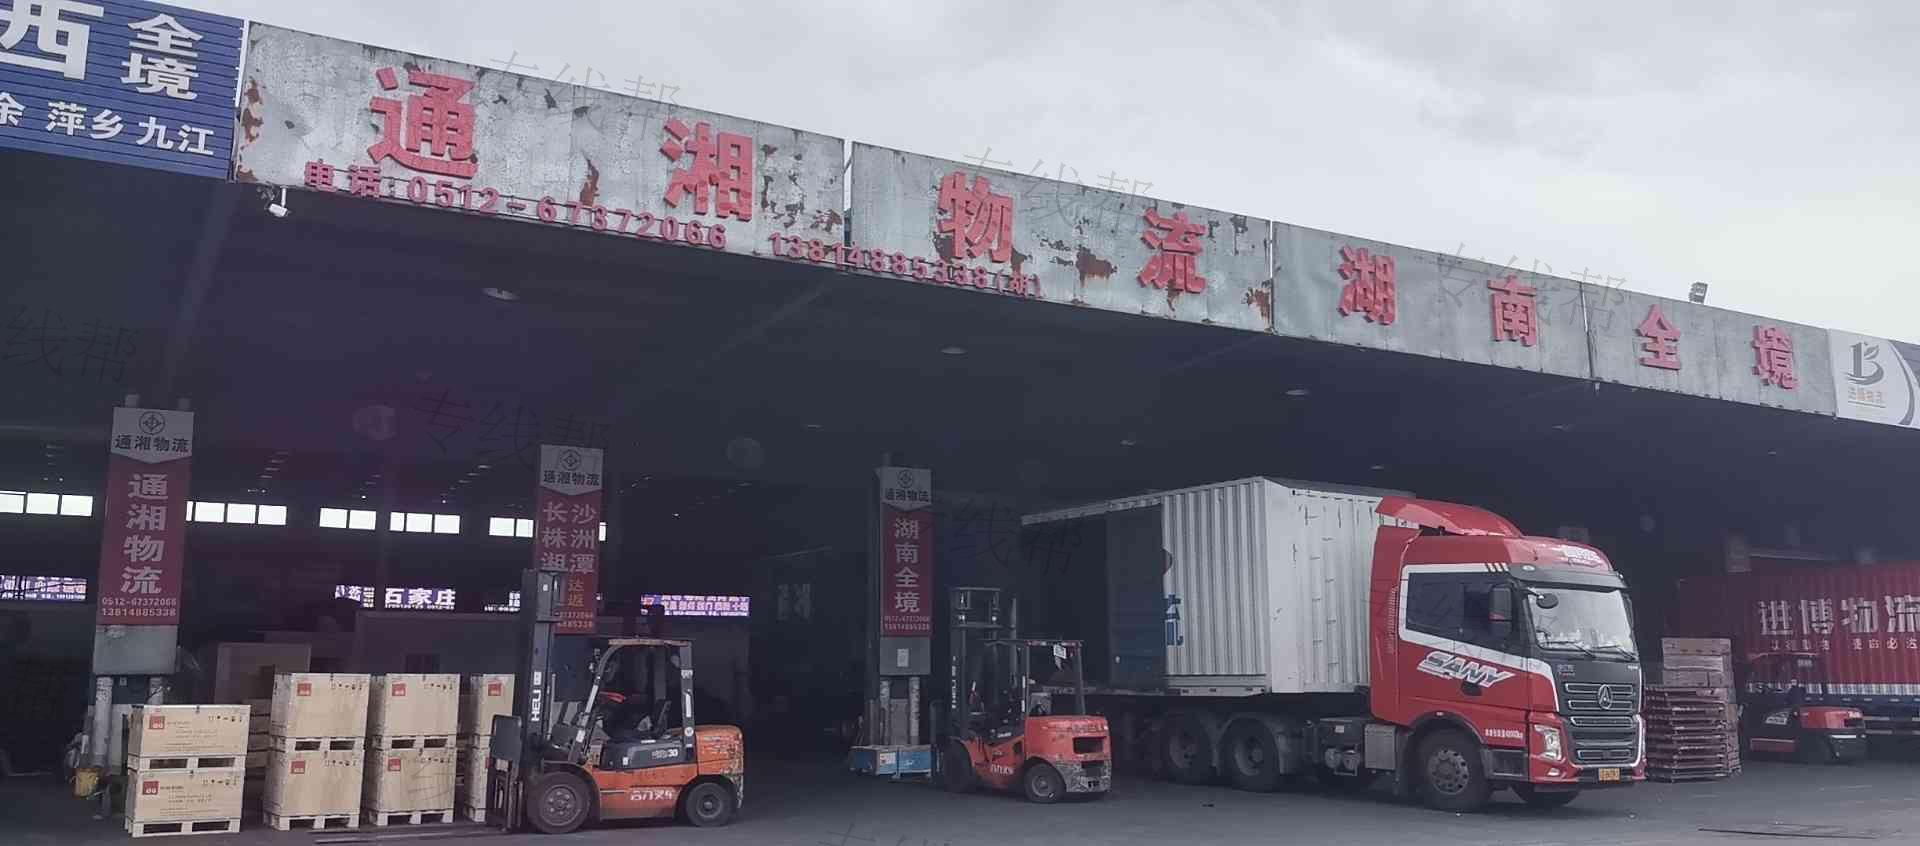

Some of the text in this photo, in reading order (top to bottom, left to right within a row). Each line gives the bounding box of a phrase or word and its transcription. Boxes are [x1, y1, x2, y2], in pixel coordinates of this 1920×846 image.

[120, 13, 203, 100] 全境
[45, 102, 125, 140] 萍乡
[136, 116, 215, 156] 九江
[114, 434, 189, 453] 通湘物流
[543, 502, 597, 525] 长沙
[121, 472, 169, 594] 通湘物流
[542, 527, 595, 549] 株洲
[895, 518, 920, 613] 湖南全境
[1416, 651, 1516, 688] SANY
[531, 689, 542, 722] HELI
